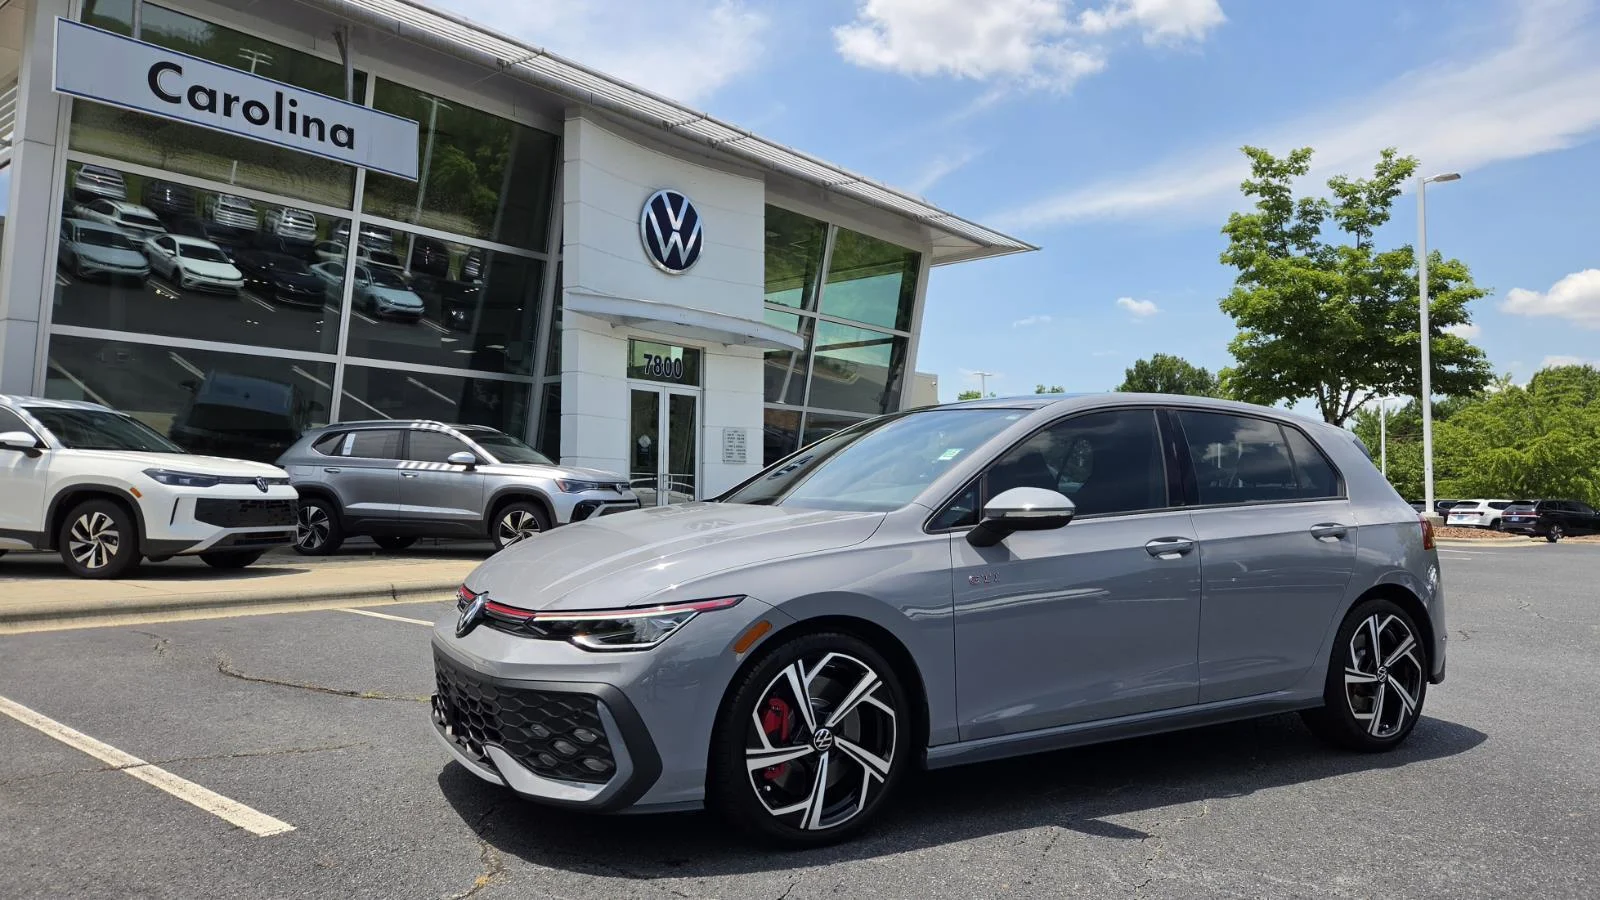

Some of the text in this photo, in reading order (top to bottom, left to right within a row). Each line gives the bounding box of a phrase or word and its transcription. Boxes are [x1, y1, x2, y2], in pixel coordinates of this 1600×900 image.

[148, 61, 354, 150] Carolina
[643, 190, 703, 271] VW
[643, 353, 683, 378] 7800
